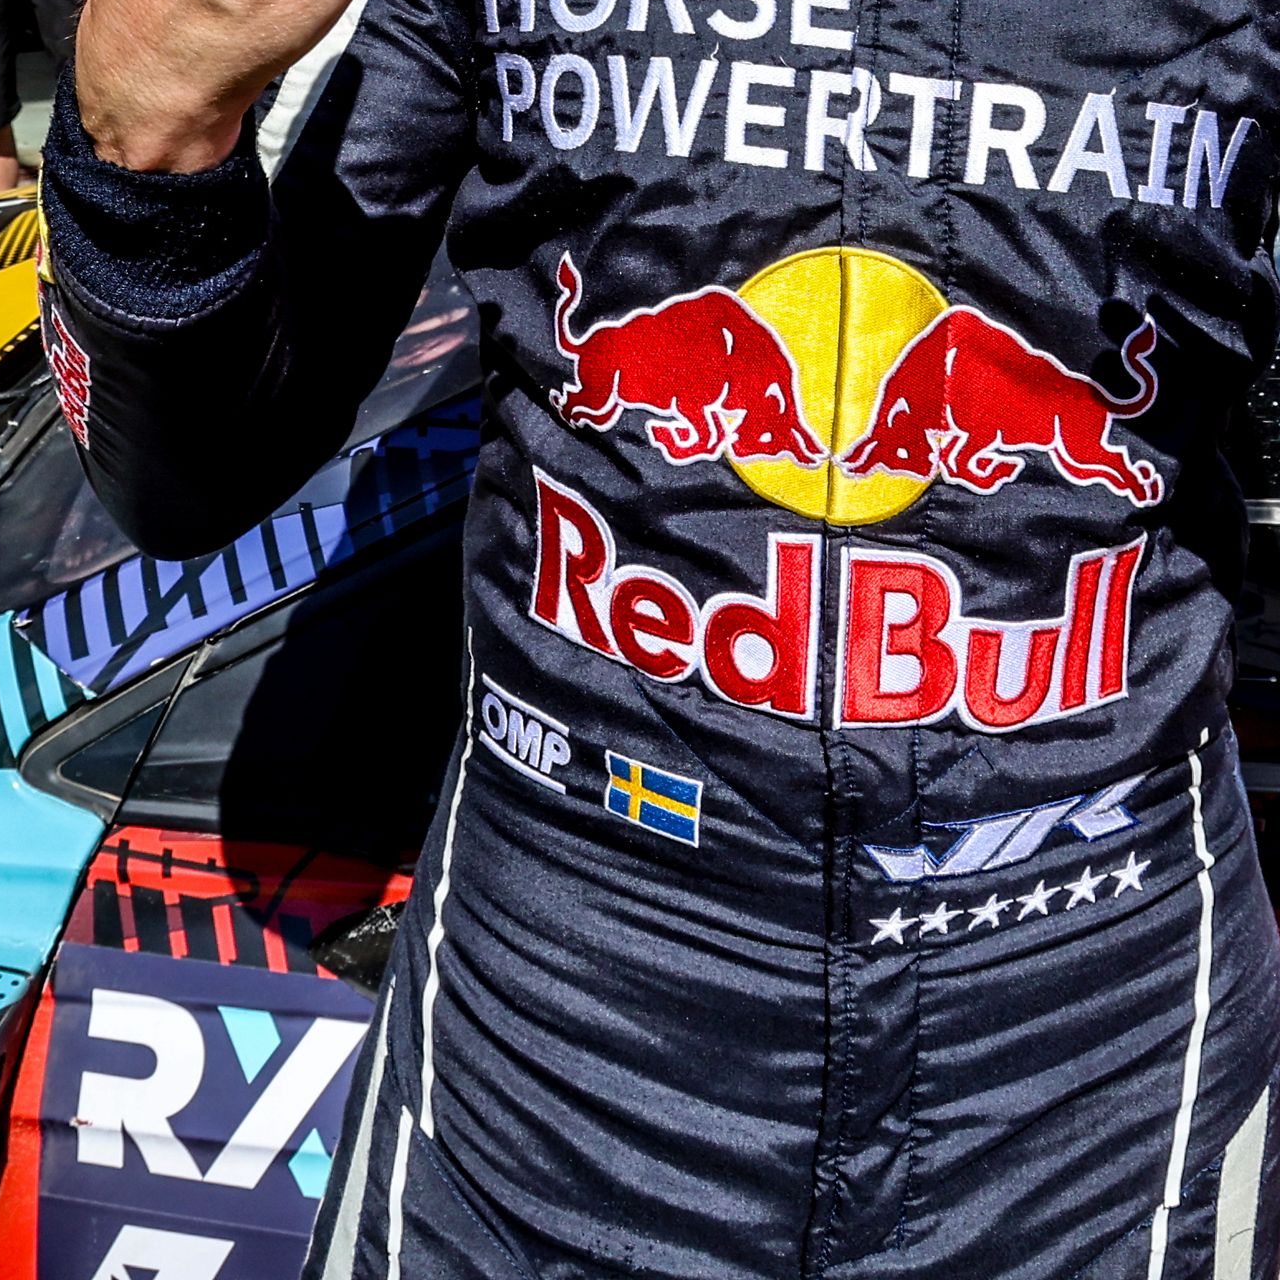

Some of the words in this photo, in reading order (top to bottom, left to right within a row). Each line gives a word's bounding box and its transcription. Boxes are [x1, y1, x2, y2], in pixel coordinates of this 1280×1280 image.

[494, 52, 1254, 209] POWERTRAIN
[527, 463, 824, 726] Red
[831, 530, 1149, 734] Bull
[481, 691, 572, 775] OMP
[76, 987, 372, 1200] RX
